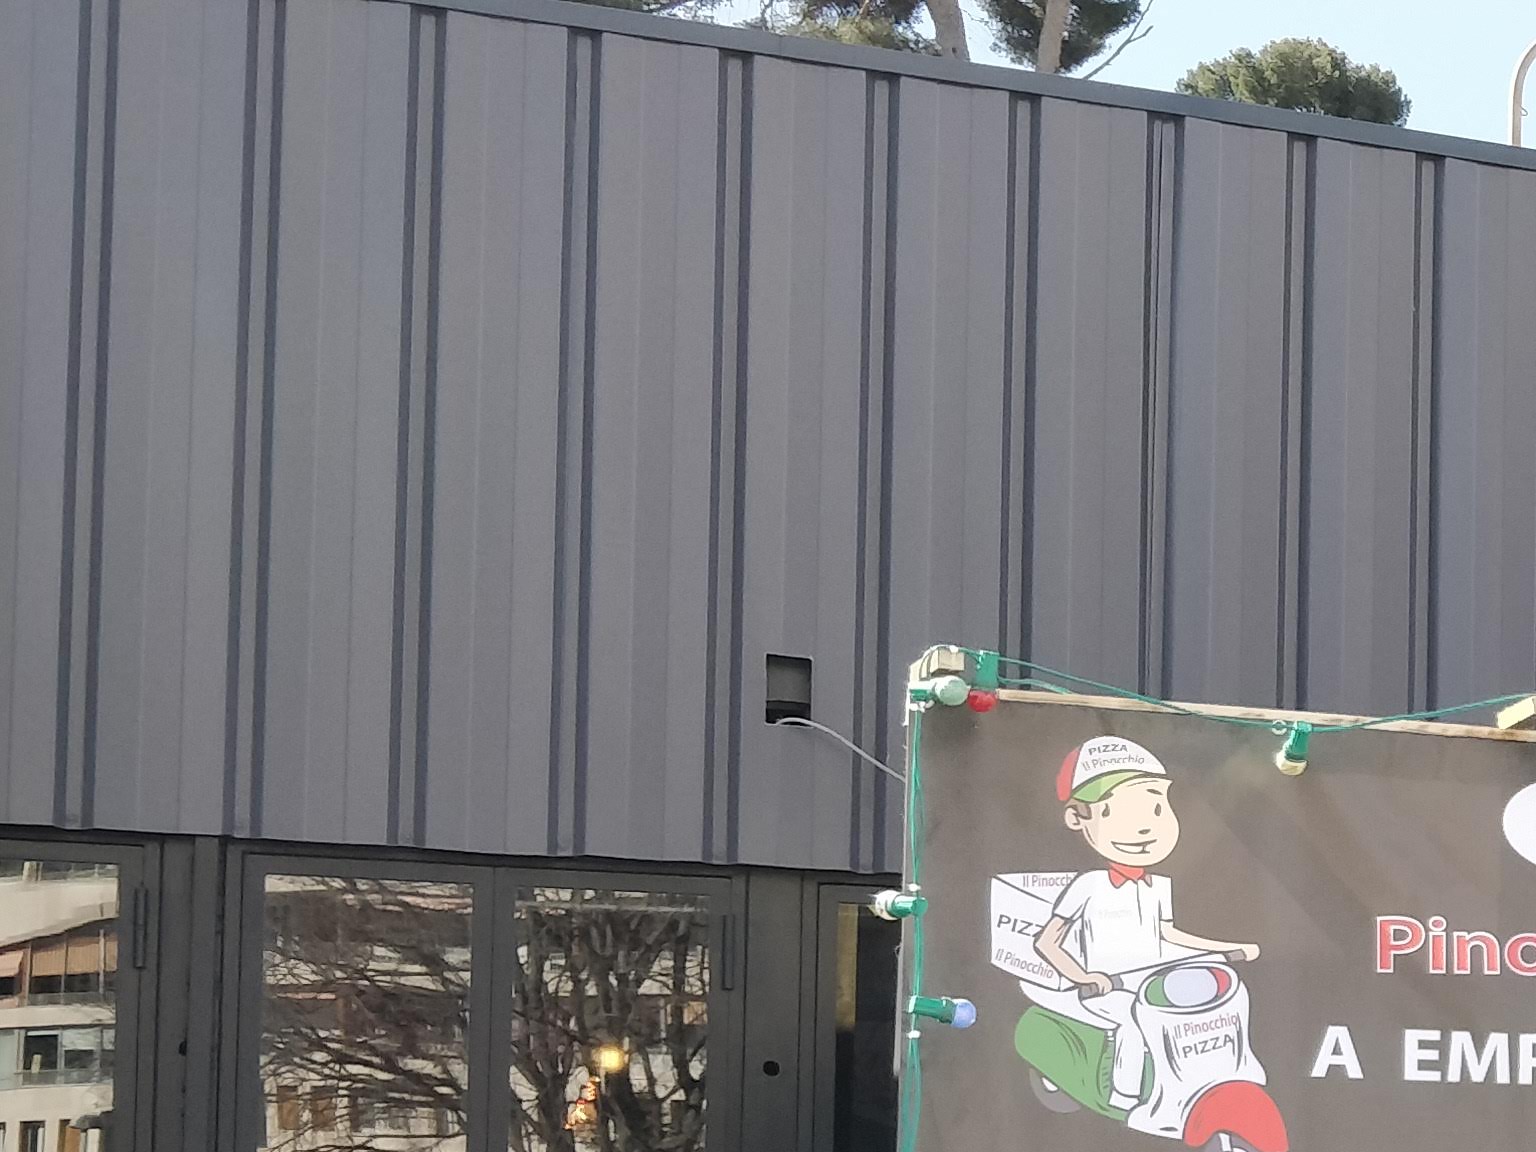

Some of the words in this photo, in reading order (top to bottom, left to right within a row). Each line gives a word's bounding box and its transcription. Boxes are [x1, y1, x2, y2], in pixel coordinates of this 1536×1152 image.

[1088, 744, 1128, 755] PIZZA
[1003, 951, 1054, 979] Pinocchio
[1183, 1012, 1238, 1037] Pinocchio
[1182, 1033, 1234, 1058] PIZZA
[1310, 1025, 1365, 1080] A
